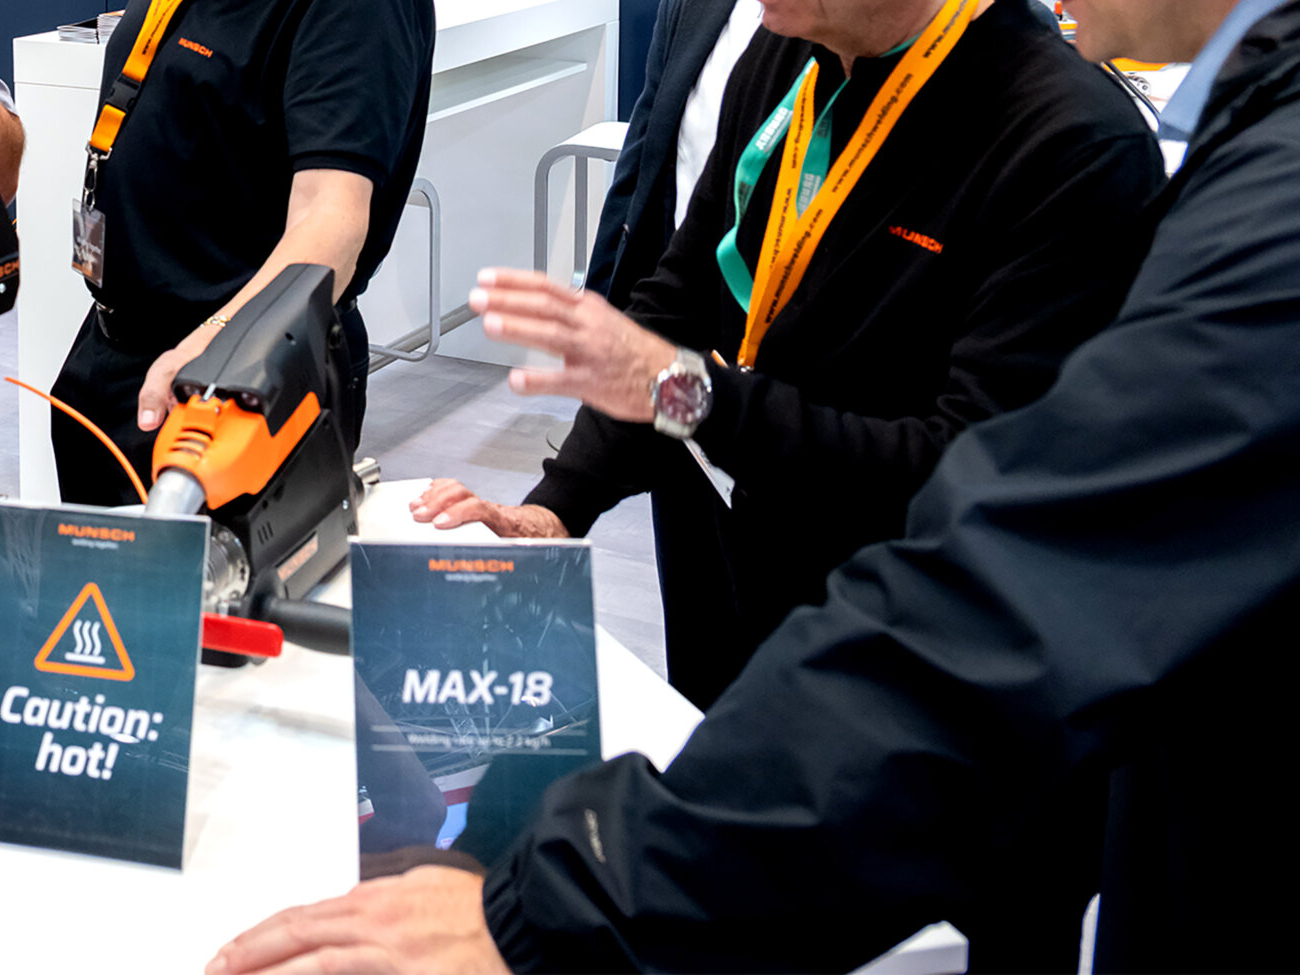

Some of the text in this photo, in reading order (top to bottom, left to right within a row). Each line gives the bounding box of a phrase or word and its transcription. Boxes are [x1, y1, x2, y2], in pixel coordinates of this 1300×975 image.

[832, 73, 914, 194] www.munschwelding.com
[889, 225, 943, 254] MUNSCH
[764, 208, 824, 325] www.munschwelding.com
[58, 523, 135, 542] MUNSCH
[428, 558, 514, 573] MUNSCH
[402, 669, 553, 706] MAX-18
[0, 685, 163, 742] Caution:
[35, 731, 118, 780] hot!
